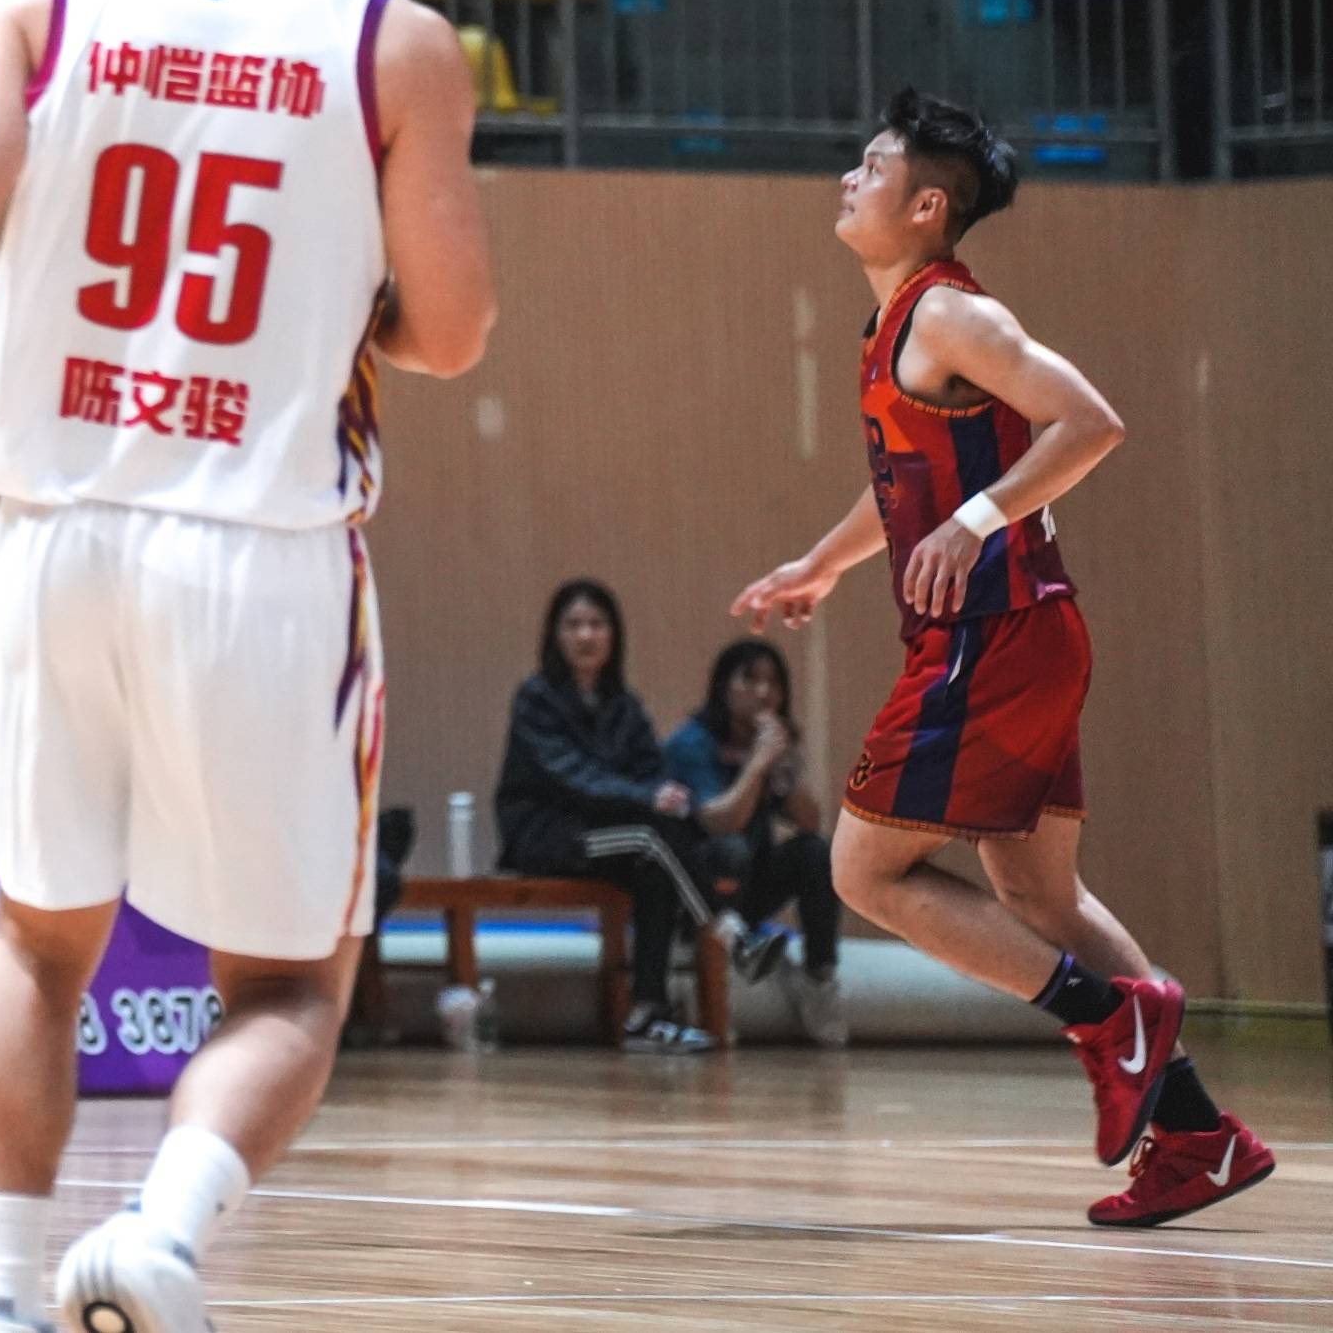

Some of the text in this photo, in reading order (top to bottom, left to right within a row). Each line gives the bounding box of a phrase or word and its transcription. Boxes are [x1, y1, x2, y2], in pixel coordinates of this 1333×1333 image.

[88, 41, 326, 119] 仲恺篮协
[76, 141, 285, 346] 95
[58, 356, 250, 447] 陈文骏
